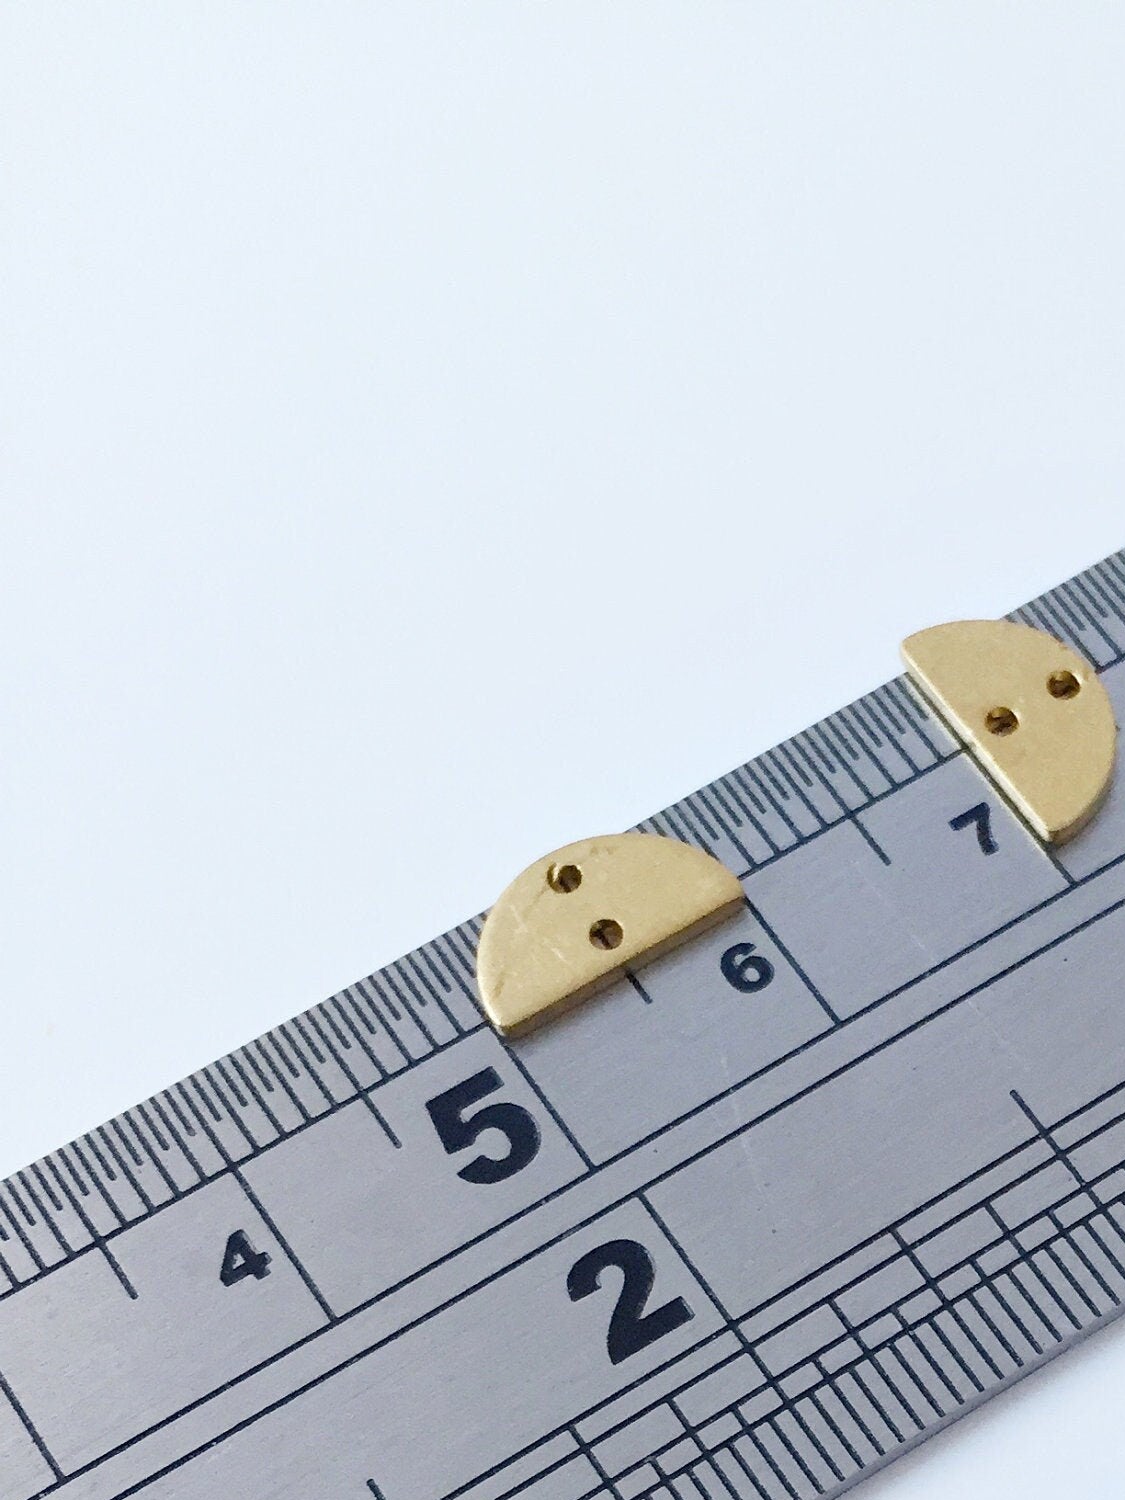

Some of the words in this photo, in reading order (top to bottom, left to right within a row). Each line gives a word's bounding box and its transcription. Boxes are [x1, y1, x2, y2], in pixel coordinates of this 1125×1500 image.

[948, 801, 999, 856] 7
[719, 942, 775, 994] 6
[424, 1065, 542, 1185] 5
[219, 1228, 272, 1287] 4
[566, 1239, 696, 1366] 2
